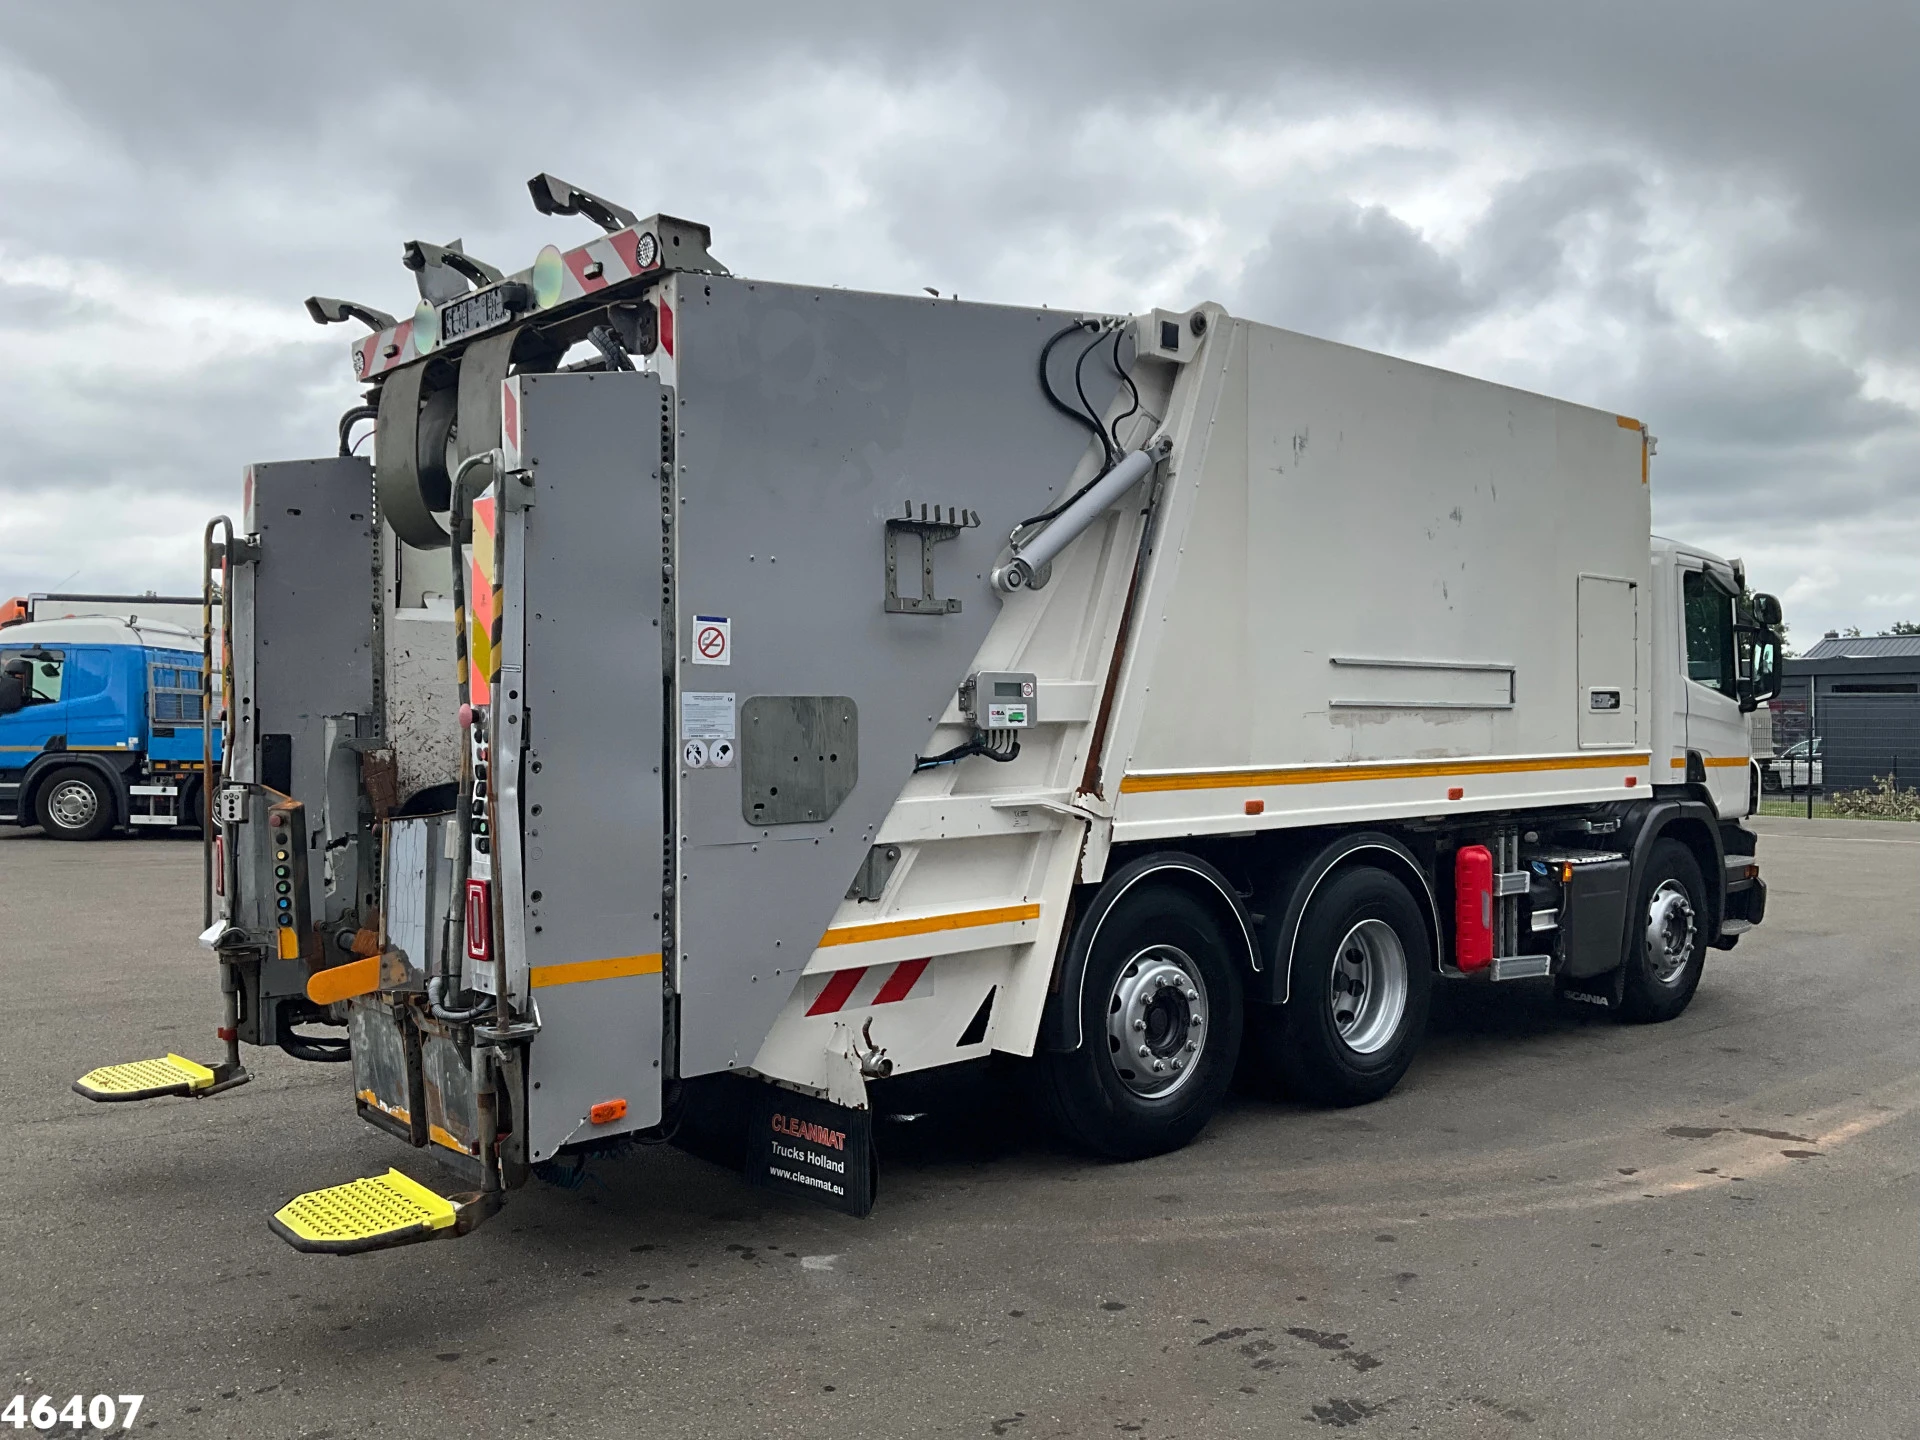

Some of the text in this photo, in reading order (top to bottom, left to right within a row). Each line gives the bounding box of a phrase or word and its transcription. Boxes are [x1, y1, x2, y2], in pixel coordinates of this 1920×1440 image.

[1563, 990, 1609, 1006] SCANIA
[771, 1113, 846, 1151] CLEANMAT
[771, 1140, 845, 1174] Trucks Holland
[769, 1165, 844, 1196] www.cleanmat.eu
